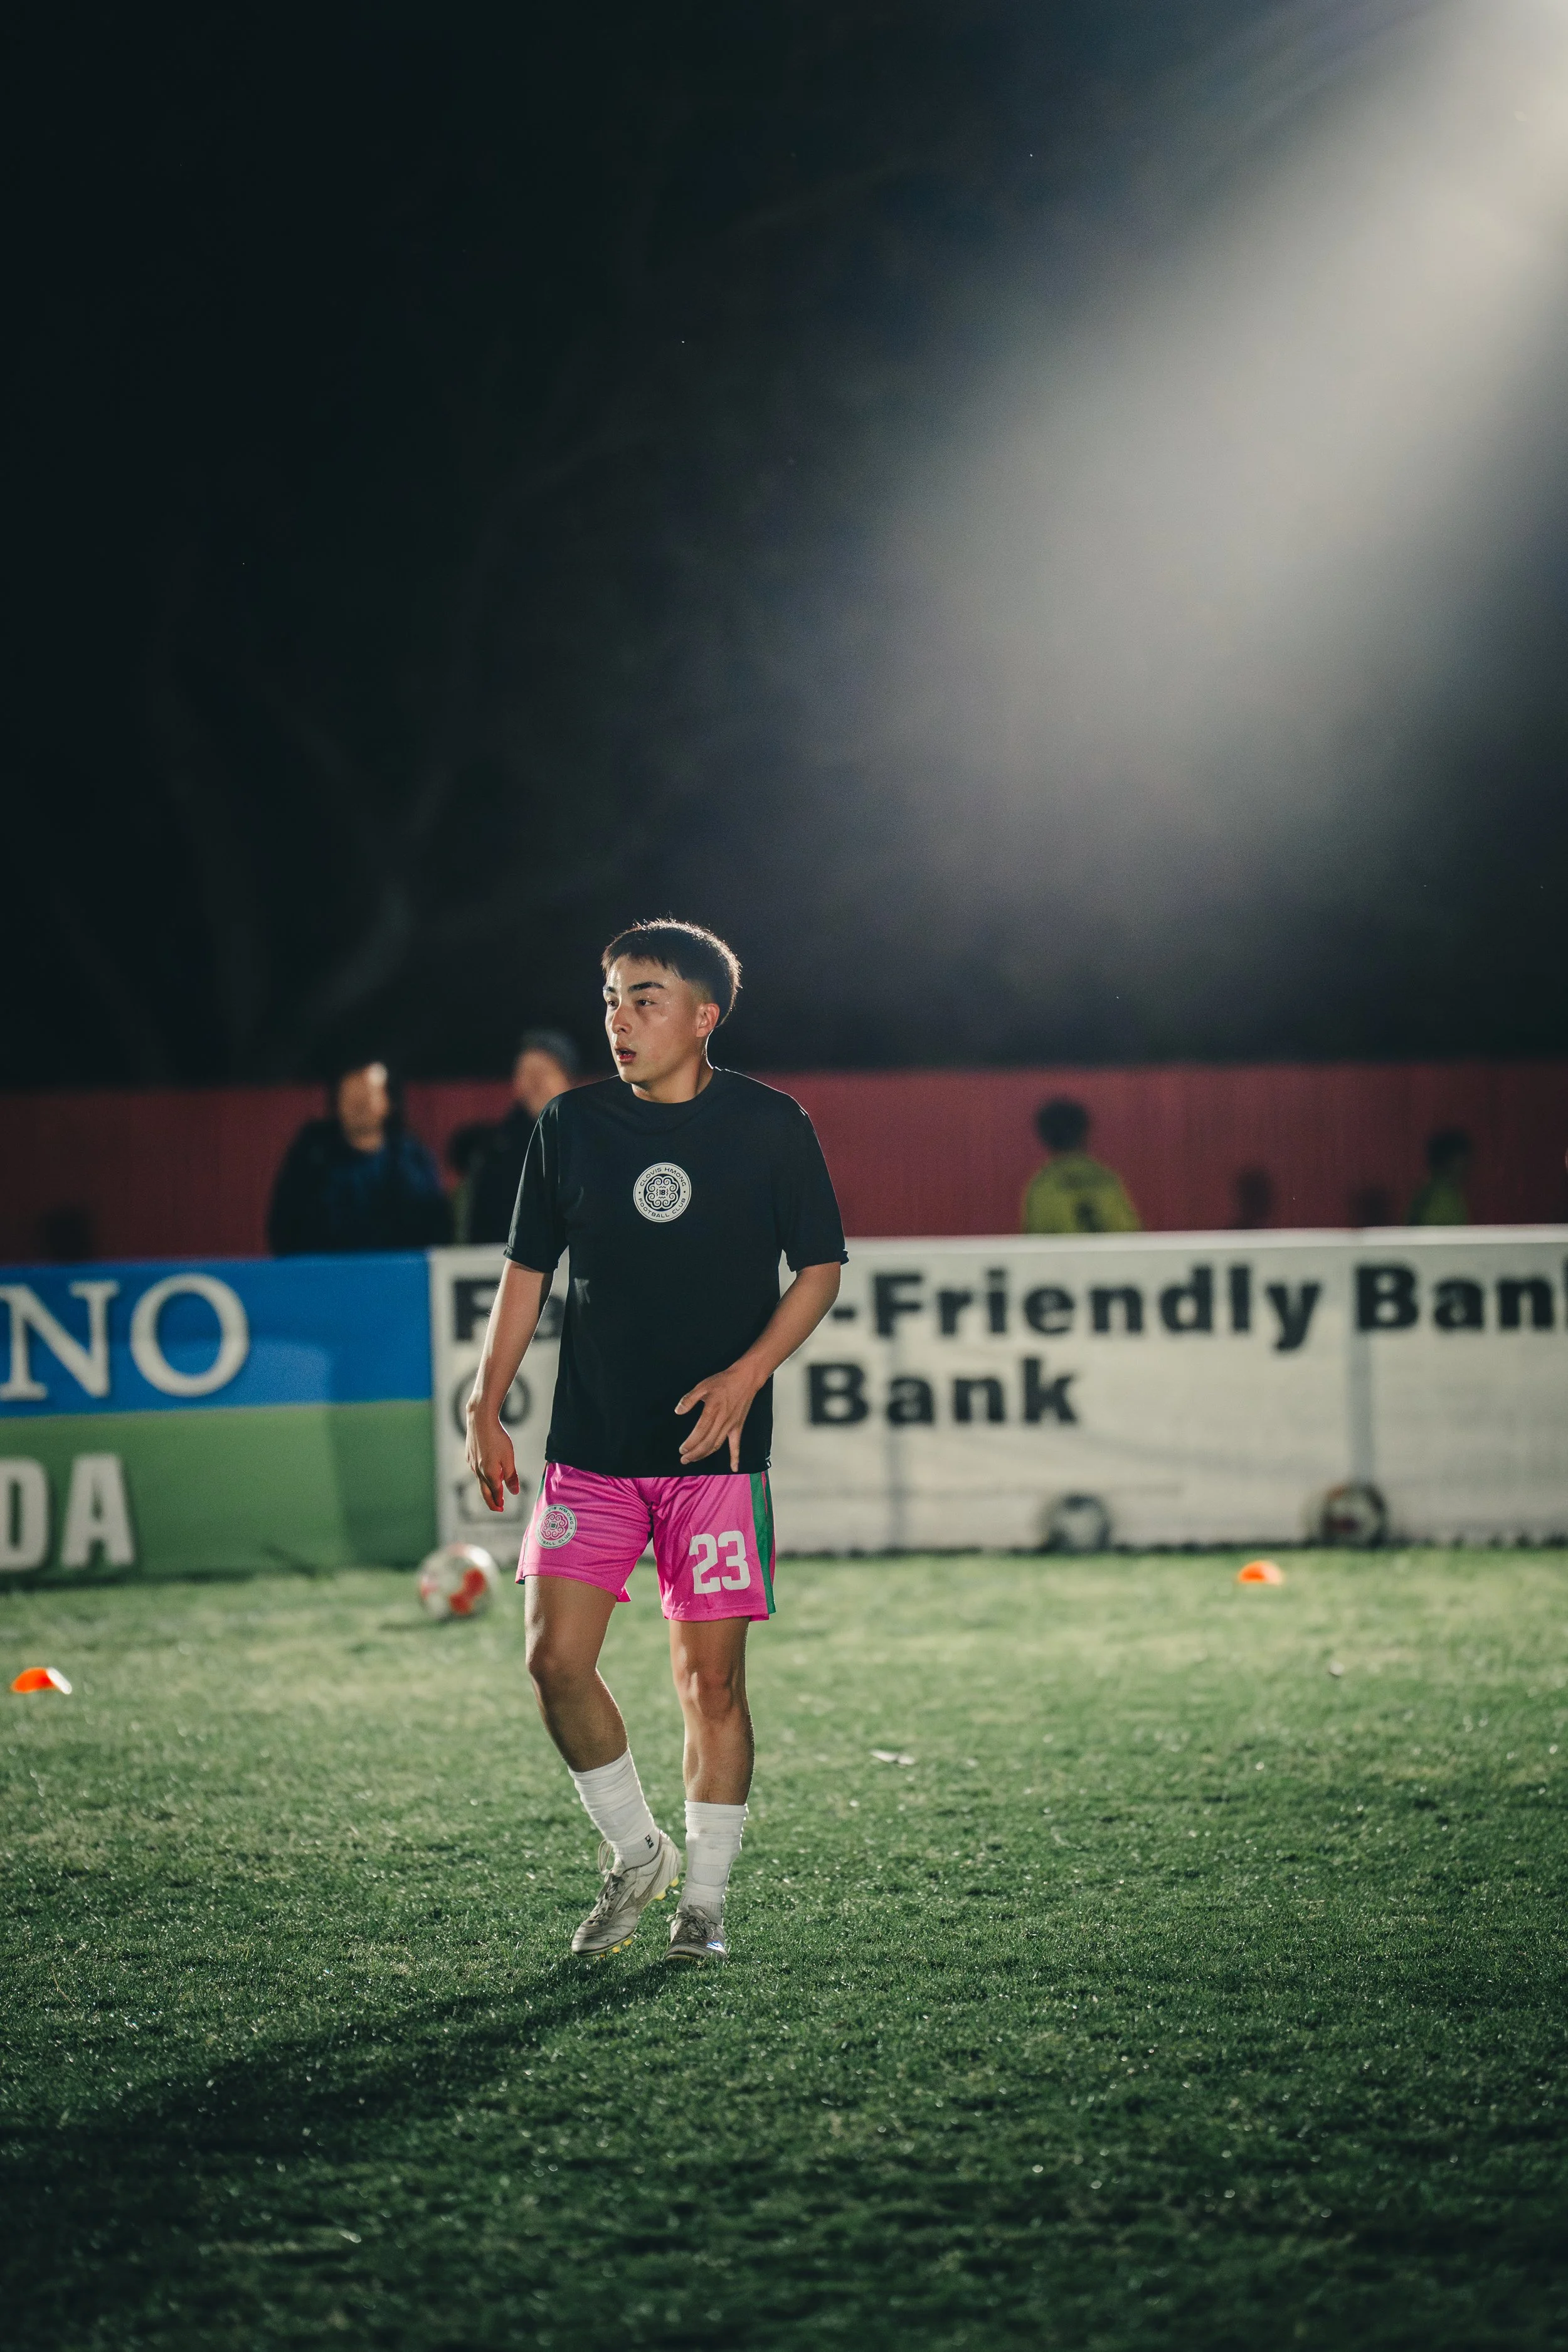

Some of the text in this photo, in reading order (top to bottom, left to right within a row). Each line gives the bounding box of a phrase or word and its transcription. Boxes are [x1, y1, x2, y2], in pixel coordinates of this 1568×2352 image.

[638, 1197, 686, 1218] FOOTBALL CLUB
[640, 1167, 686, 1187] CLOVIS HMONG
[1354, 1258, 1568, 1332] Ban
[806, 1356, 1078, 1426] Bank
[689, 1530, 751, 1594] 23
